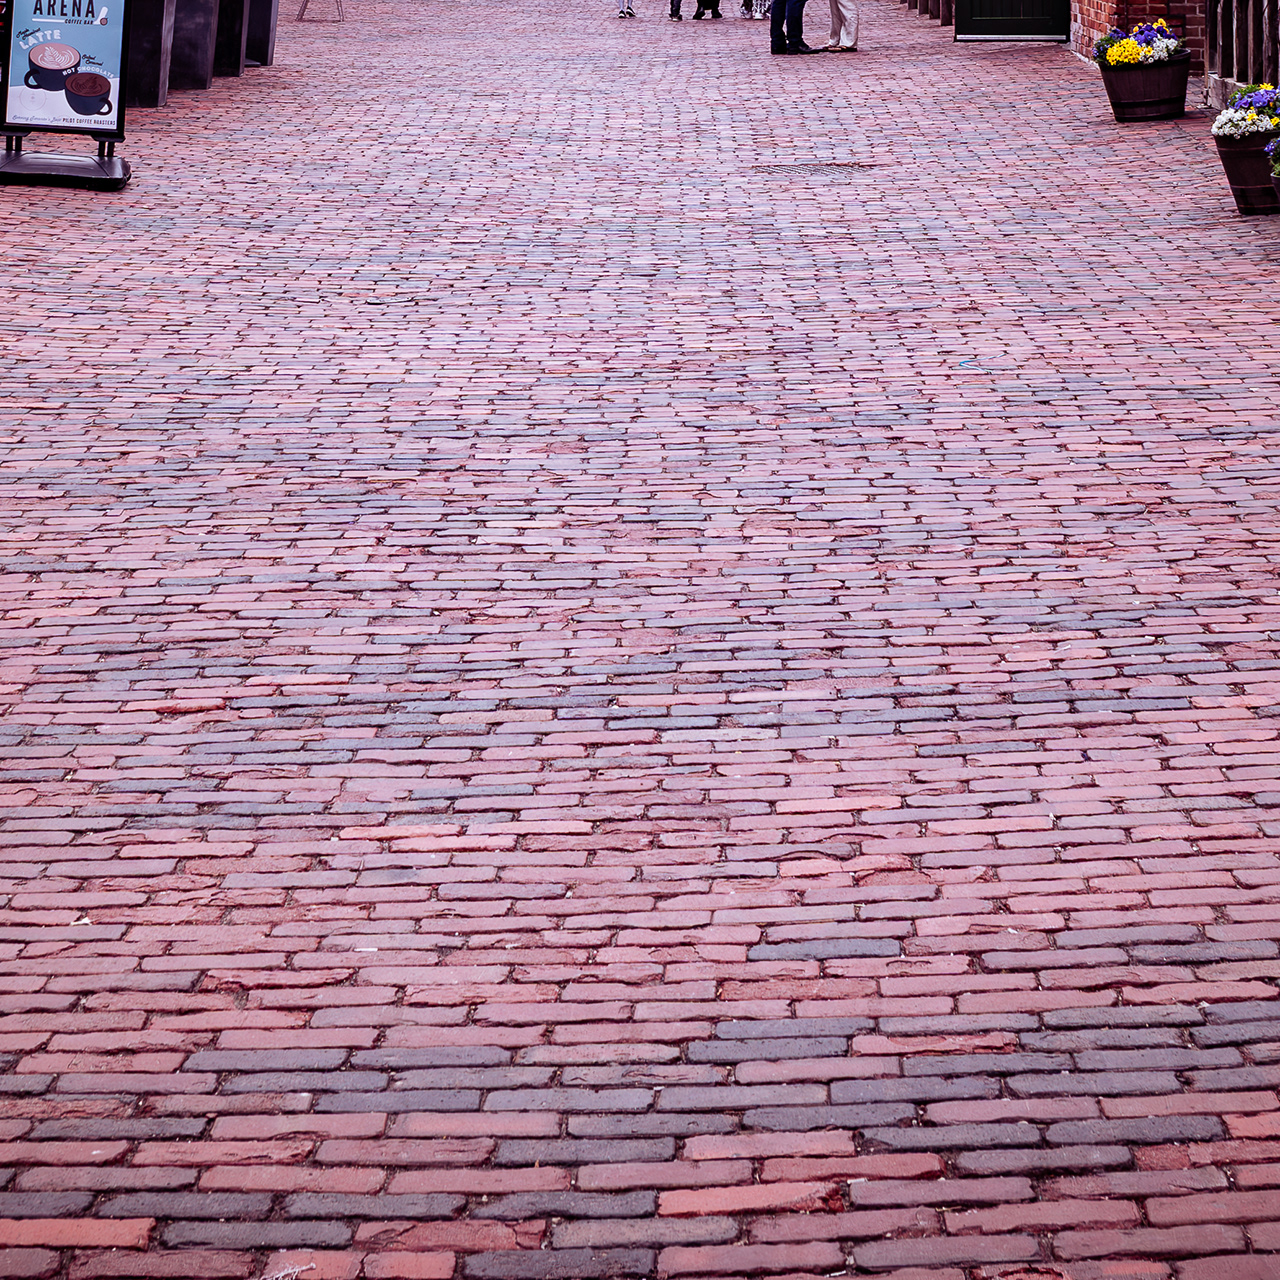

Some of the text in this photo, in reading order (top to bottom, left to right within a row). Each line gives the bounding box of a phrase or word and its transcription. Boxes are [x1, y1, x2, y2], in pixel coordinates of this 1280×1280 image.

[19, 29, 61, 51] LATTE
[62, 66, 115, 79] HOT CHOCOLATE
